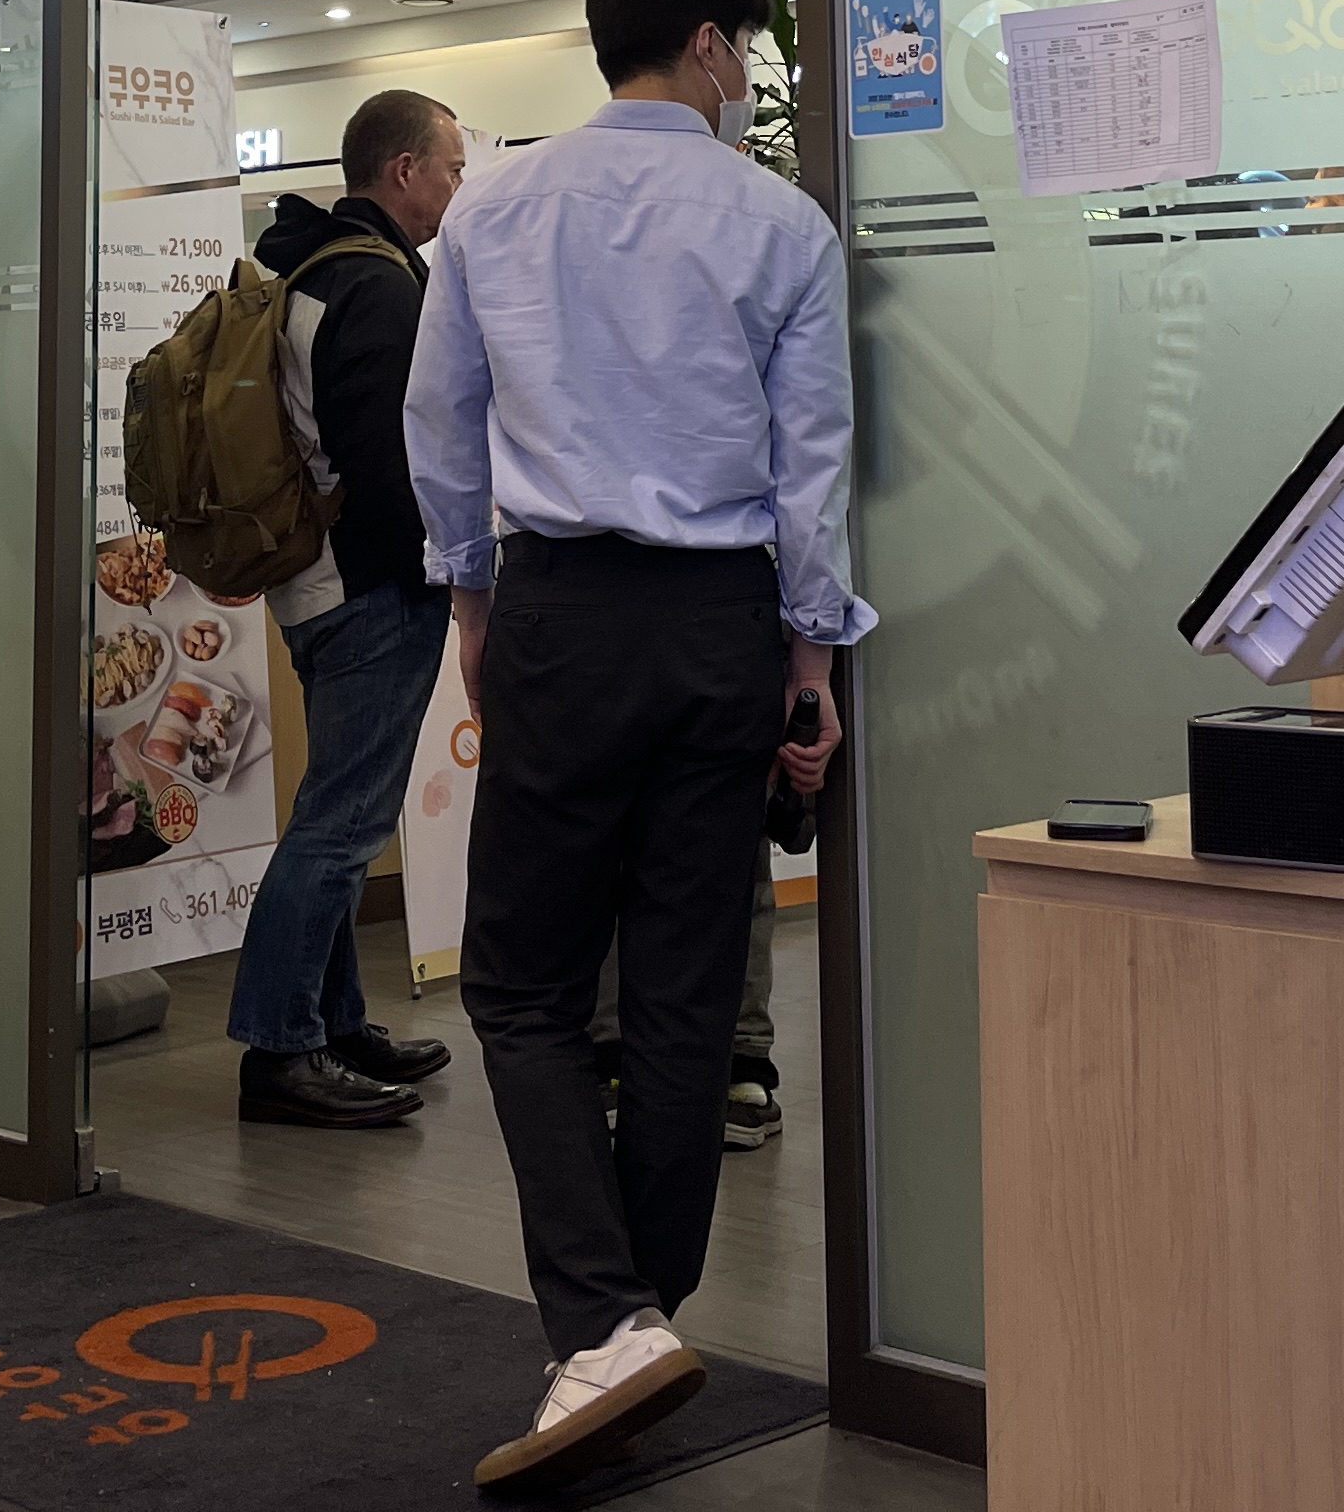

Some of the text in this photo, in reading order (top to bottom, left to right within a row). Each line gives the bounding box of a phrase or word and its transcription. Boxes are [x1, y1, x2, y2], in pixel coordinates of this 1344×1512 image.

[871, 43, 920, 68] 안심식당
[108, 64, 196, 114] 쿠우쿠우
[159, 115, 181, 126] Salad
[182, 117, 196, 126] Bar
[159, 803, 198, 828] BBQ
[96, 880, 260, 944] 부평점 361.405
